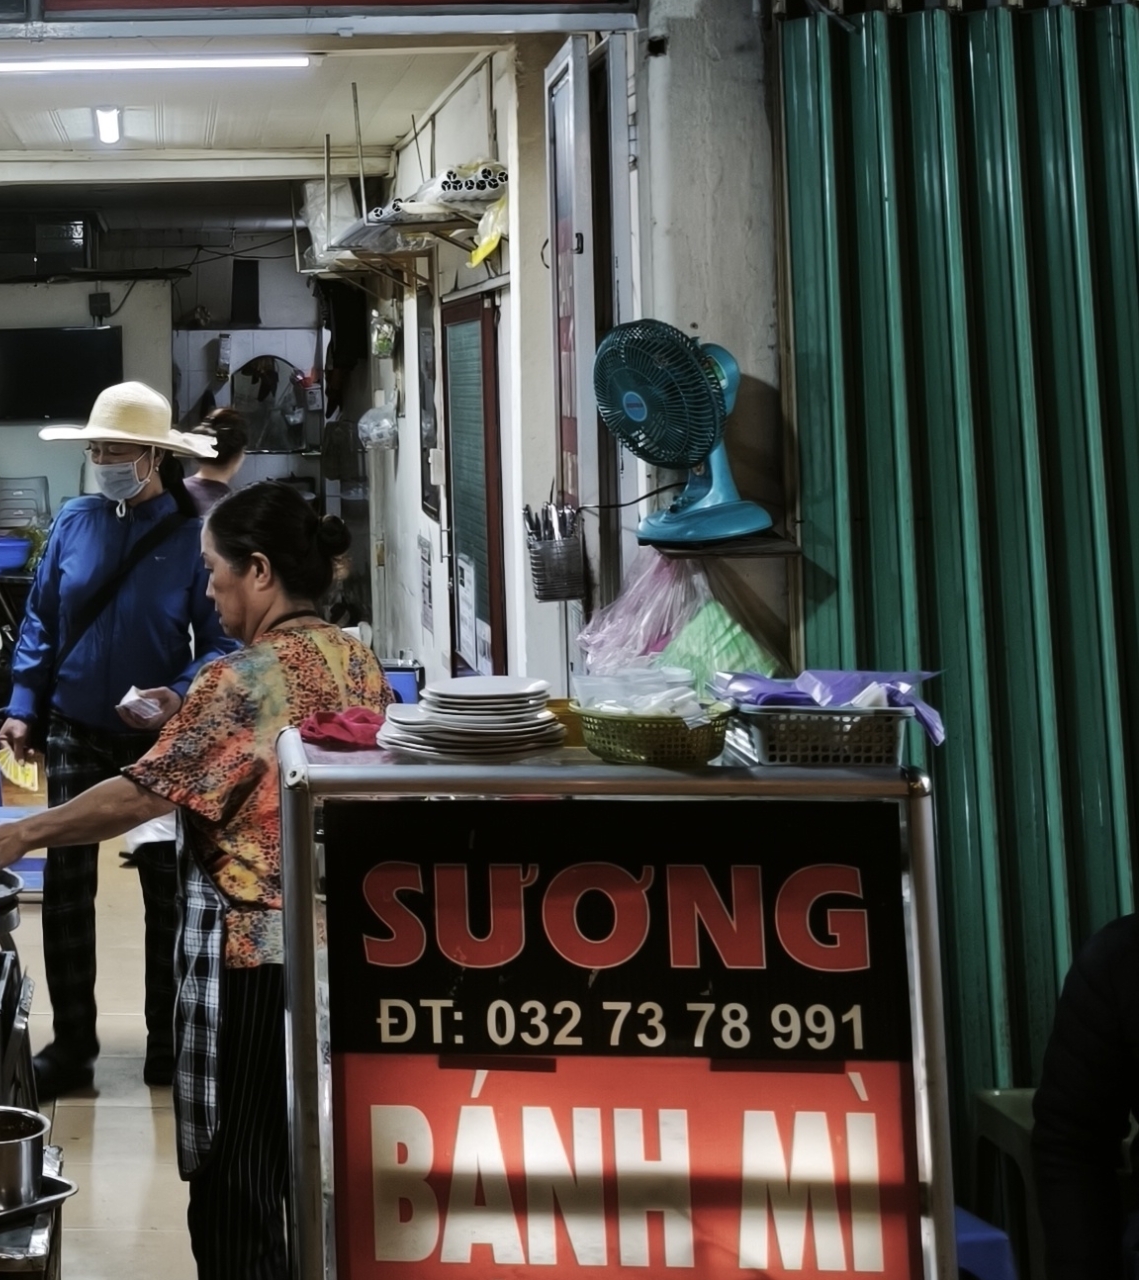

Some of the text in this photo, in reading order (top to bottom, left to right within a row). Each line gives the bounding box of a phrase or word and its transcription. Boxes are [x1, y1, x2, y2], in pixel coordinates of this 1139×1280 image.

[361, 859, 872, 974] SƯƠNG
[375, 998, 865, 1052] ĐT: 032 73 78 991
[369, 1069, 886, 1275] BÁNH MÌ
